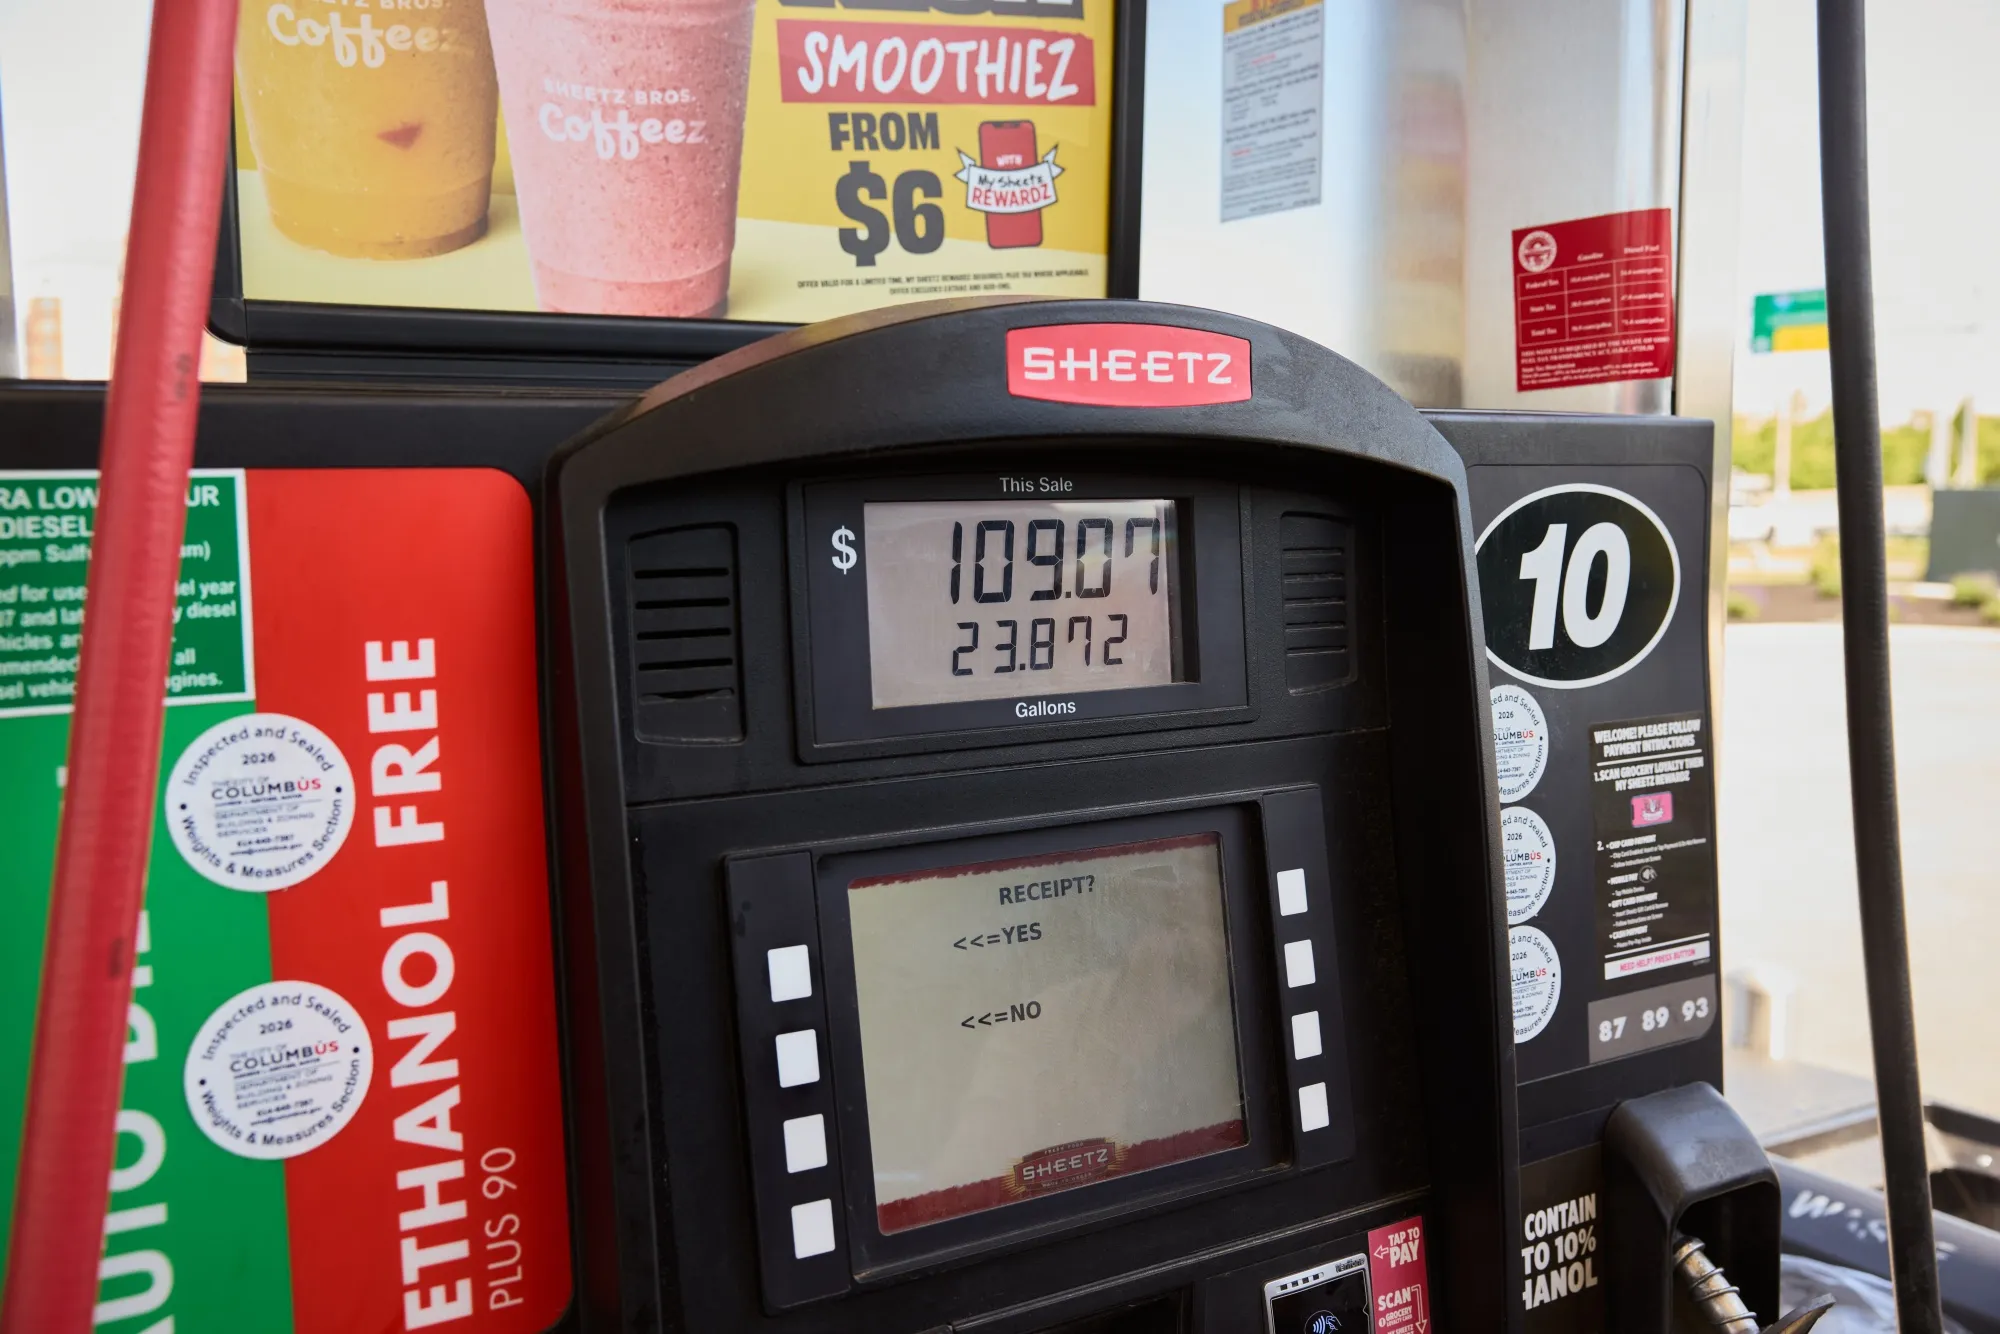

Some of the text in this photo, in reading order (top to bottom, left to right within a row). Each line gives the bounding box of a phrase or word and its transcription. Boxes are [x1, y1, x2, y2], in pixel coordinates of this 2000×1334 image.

[267, 4, 461, 68] Coffeez
[798, 31, 1079, 101] SMOOTHIEZ
[544, 78, 697, 105] SHEETZ BROS.
[538, 102, 707, 160] Coffeez
[828, 112, 941, 151] FROM
[979, 174, 994, 190] My
[972, 183, 1052, 208] REWARDZ
[835, 161, 945, 267] $6
[1023, 347, 1233, 384] SHEETZ
[999, 477, 1073, 492] This Sale
[37, 486, 99, 509] LOW
[0, 515, 95, 540] DIESEL
[45, 543, 93, 563] Sulf
[831, 517, 1161, 605] $ 109.07
[199, 580, 236, 600] year
[1519, 522, 1631, 650] 10
[20, 607, 57, 628] and
[60, 606, 85, 626] lat
[187, 600, 236, 620] diesel
[952, 613, 1128, 675] 23.872
[175, 648, 196, 666] all
[27, 677, 78, 699] vehic
[1015, 700, 1076, 718] Gallons
[1498, 711, 1514, 719] 2026
[1494, 728, 1535, 741] OLUMBUS
[1638, 723, 1668, 738] PLEASE
[1668, 719, 1701, 735] FOLLOW
[183, 726, 334, 786] Inspected and Sealed
[242, 752, 276, 765] 2026
[1603, 741, 1641, 757] PAYMENT
[1620, 763, 1654, 779] GROCERY
[211, 777, 322, 800] COLUMBUS
[182, 798, 342, 879] Weights & Measures Section
[1507, 833, 1523, 841] 2026
[1503, 850, 1542, 863] LUMBUS
[999, 875, 1096, 905] RECEIPT?
[1508, 900, 1535, 917] easures
[1512, 952, 1527, 961] 2026
[365, 638, 474, 1331] ETHANOL FREE
[1511, 966, 1547, 982] LUMBUS
[202, 993, 352, 1061] Inspected and Sealed
[259, 1019, 293, 1035] 2026
[1515, 1016, 1542, 1036] easures
[1598, 997, 1709, 1043] 87 89 93
[229, 1040, 340, 1073] COLUMBUS
[202, 1090, 242, 1140] Weights
[246, 1133, 256, 1144] &
[262, 1115, 333, 1146] Measures
[332, 1058, 360, 1113] Section
[1022, 1148, 1109, 1181] SHEETZ
[480, 1146, 523, 1311] PLUS 90
[1524, 1192, 1596, 1241] CONTAIN
[1388, 1226, 1420, 1247] TAP TO
[1389, 1239, 1420, 1269] PAY
[1521, 1225, 1597, 1276] TO 10%
[1377, 1286, 1412, 1312] SCAN
[1385, 1305, 1412, 1321] GROCERY
